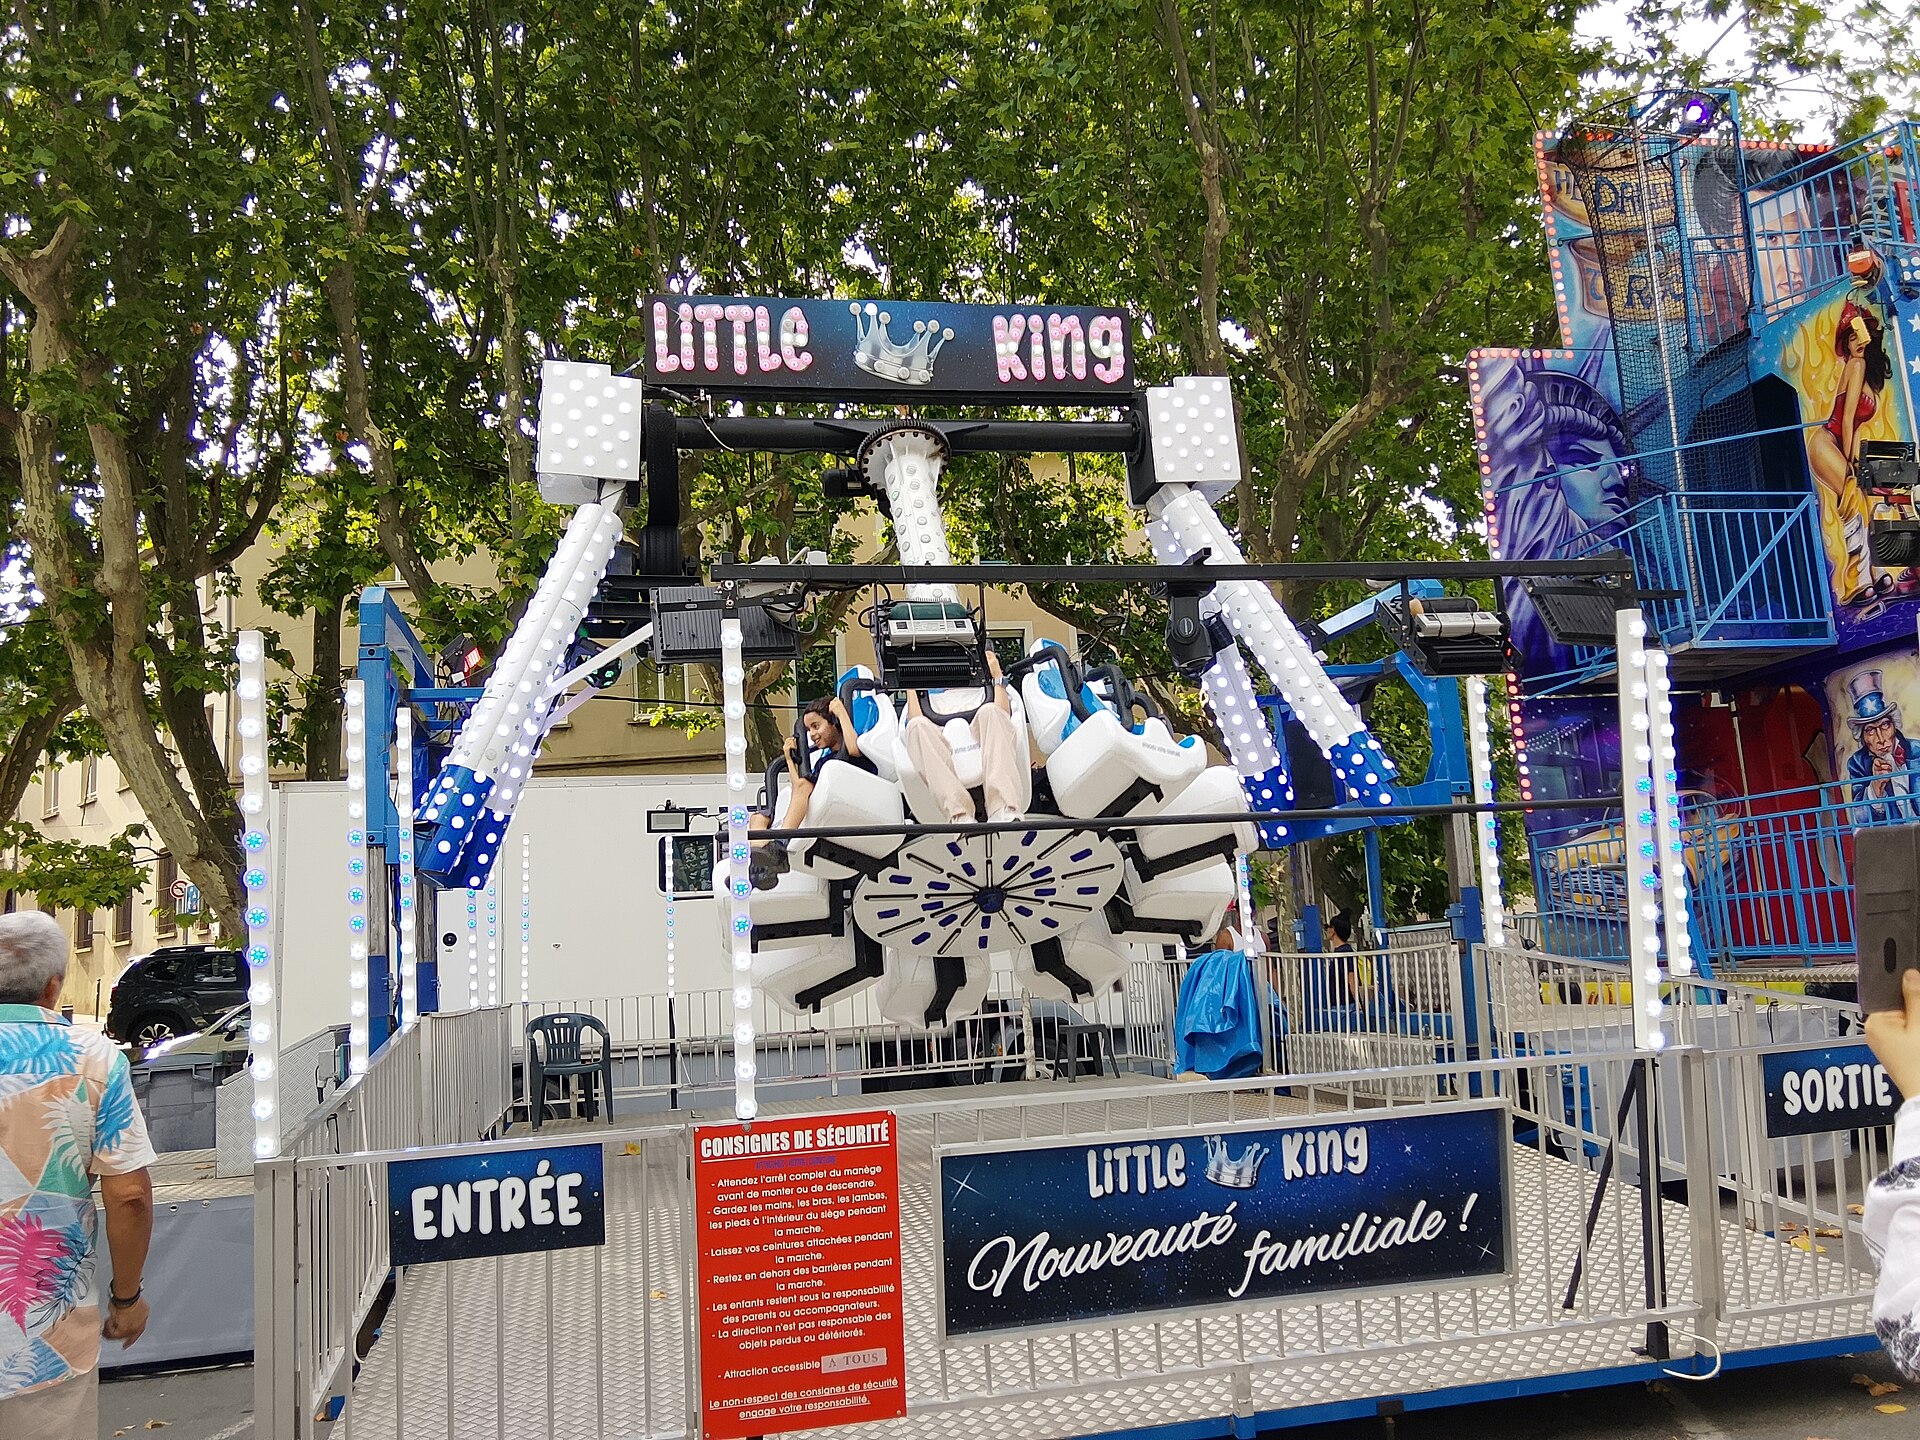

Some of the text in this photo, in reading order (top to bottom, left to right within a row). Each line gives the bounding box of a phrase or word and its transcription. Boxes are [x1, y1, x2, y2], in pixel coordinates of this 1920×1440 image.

[1782, 1064, 1893, 1116] SORTIE
[701, 1120, 889, 1157] CONSIGNES DE SÉCURITÉ
[718, 1166, 881, 1187] Attendez l'arrêt complet du manège
[411, 1159, 583, 1241] ENTRÉE
[718, 1191, 744, 1201] avant
[746, 1190, 759, 1198] de
[762, 1188, 794, 1197] monter
[810, 1184, 823, 1192] de
[714, 1206, 747, 1215] Gardez
[725, 1218, 750, 1229] pieds
[752, 1216, 759, 1225] à
[762, 1214, 803, 1224] l'intérieur
[821, 1209, 845, 1219] siège
[848, 1205, 886, 1217] pendant
[711, 1247, 742, 1256] Laissez
[763, 1241, 804, 1251] ceintures
[807, 1235, 852, 1246] attachées
[855, 1231, 892, 1243] pendant
[967, 1201, 1239, 1298] Nouveauté
[1228, 1199, 1447, 1297] familiale
[714, 1274, 742, 1283] Restez
[760, 1270, 790, 1278] dehors
[812, 1263, 851, 1273] barrières
[854, 1258, 892, 1270] pendant
[730, 1299, 763, 1309] enfants
[767, 1295, 796, 1305] restent
[800, 1294, 819, 1302] sous
[833, 1284, 894, 1298] responsabilité
[718, 1330, 728, 1338] La
[732, 1326, 772, 1336] direction
[776, 1322, 795, 1331] n'est
[799, 1321, 815, 1330] pas
[818, 1314, 872, 1327] responsable
[723, 1316, 739, 1324] des
[742, 1311, 776, 1323] parents
[740, 1339, 767, 1350] objets
[770, 1336, 801, 1347] perdus
[724, 1368, 768, 1379] Attraction
[772, 1361, 820, 1373] accessible
[843, 1352, 879, 1366] TOUS
[723, 1393, 778, 1406] non-respect
[800, 1386, 845, 1397] consignes
[847, 1383, 860, 1392] de
[863, 1378, 897, 1390] sécurité
[740, 1408, 776, 1418] engage
[779, 1404, 802, 1413] votre
